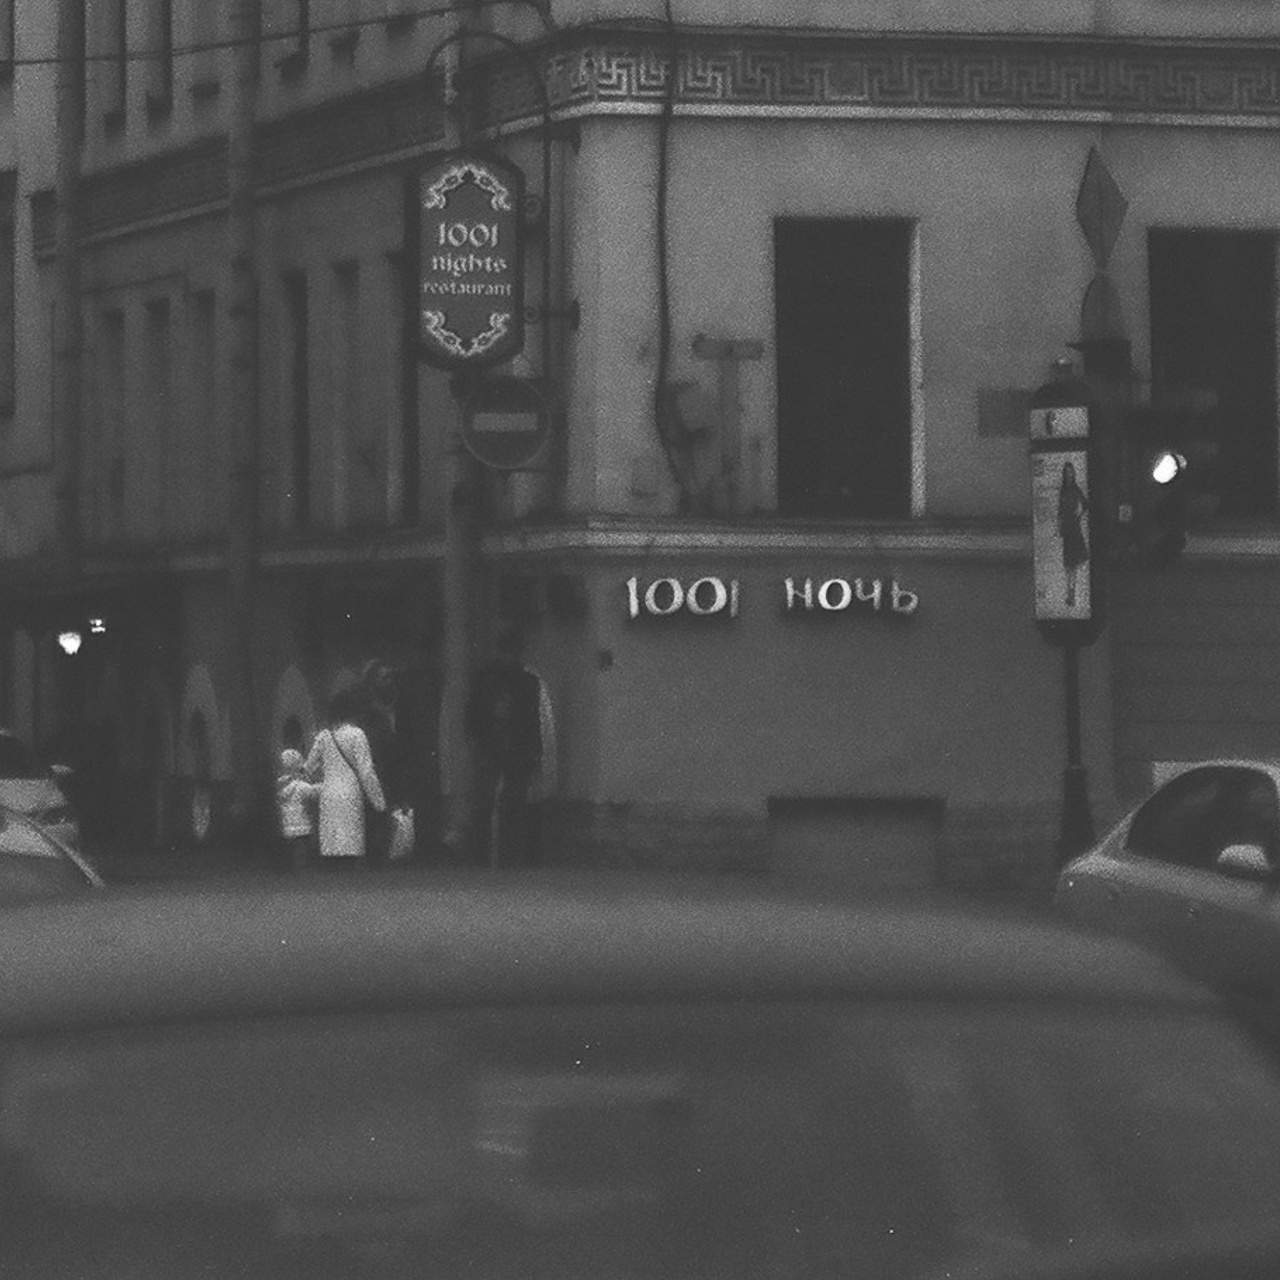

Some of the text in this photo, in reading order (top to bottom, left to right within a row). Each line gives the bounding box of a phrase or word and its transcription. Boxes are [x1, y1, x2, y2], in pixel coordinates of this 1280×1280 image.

[439, 222, 498, 248] 1001
[432, 252, 508, 277] nights
[423, 280, 512, 297] restaurant
[626, 576, 739, 619] 1001
